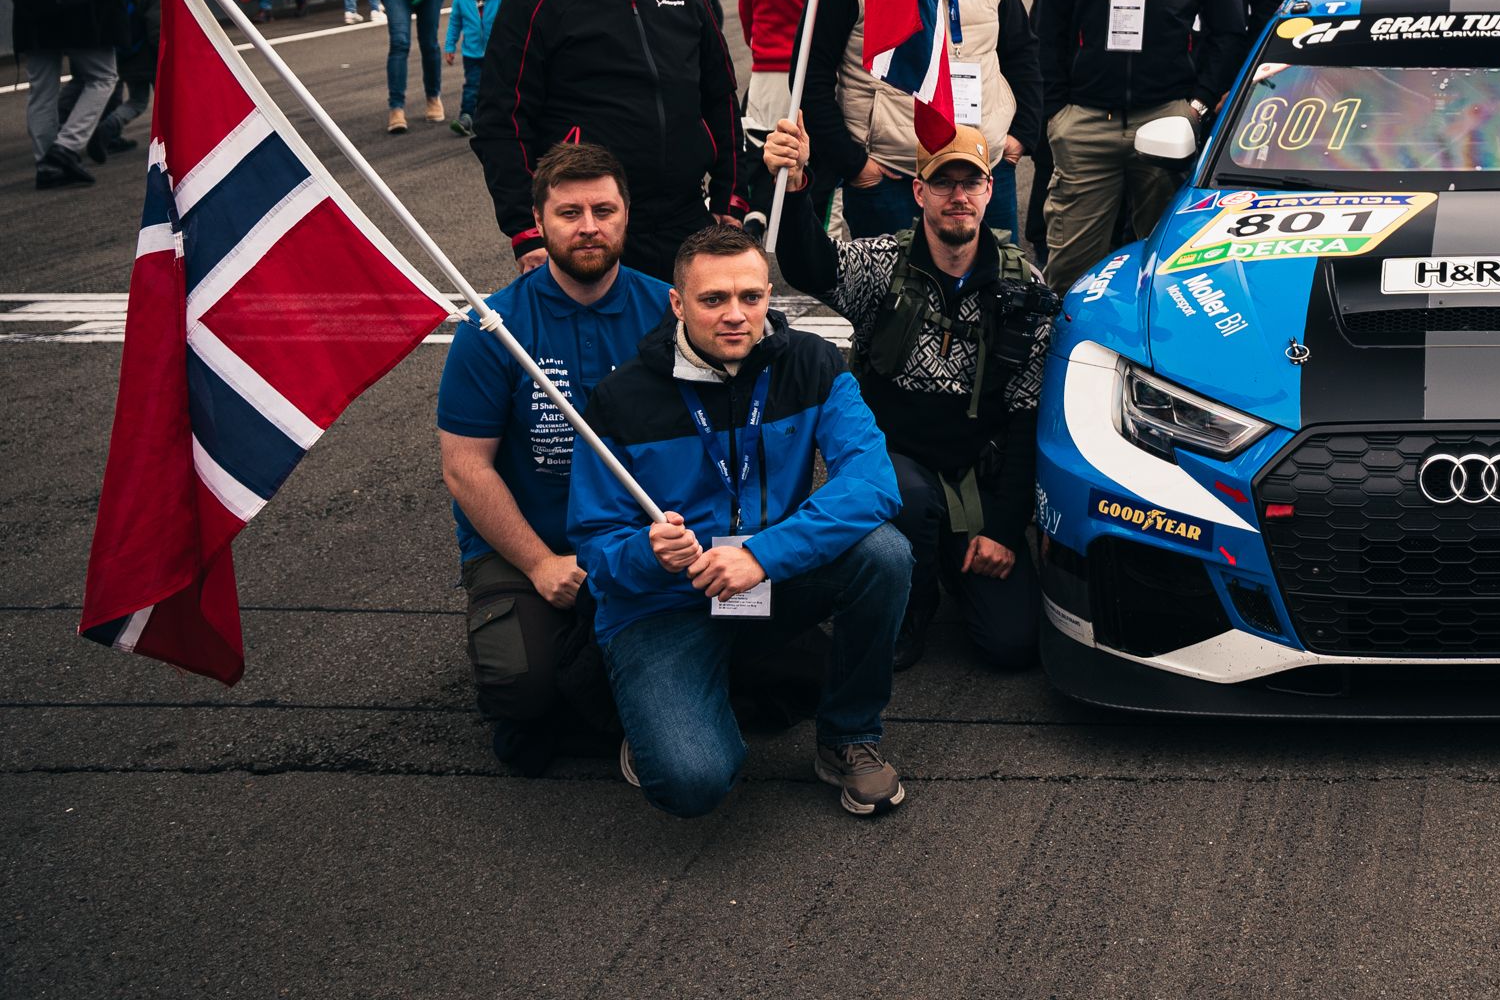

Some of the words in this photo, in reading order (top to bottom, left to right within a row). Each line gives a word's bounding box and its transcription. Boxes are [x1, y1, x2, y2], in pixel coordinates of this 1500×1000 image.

[1370, 15, 1454, 35] GRAN
[1371, 34, 1399, 42] THE
[1402, 32, 1440, 40] REAL
[1238, 96, 1362, 151] 801
[1256, 196, 1401, 208] RAVENOL
[1226, 210, 1374, 237] 801
[1226, 238, 1349, 258] DEKRA
[1166, 284, 1197, 317] Motorsport
[1214, 312, 1249, 337] Bil
[540, 411, 565, 421] Aars
[1097, 499, 1202, 541] GOODYEAR
